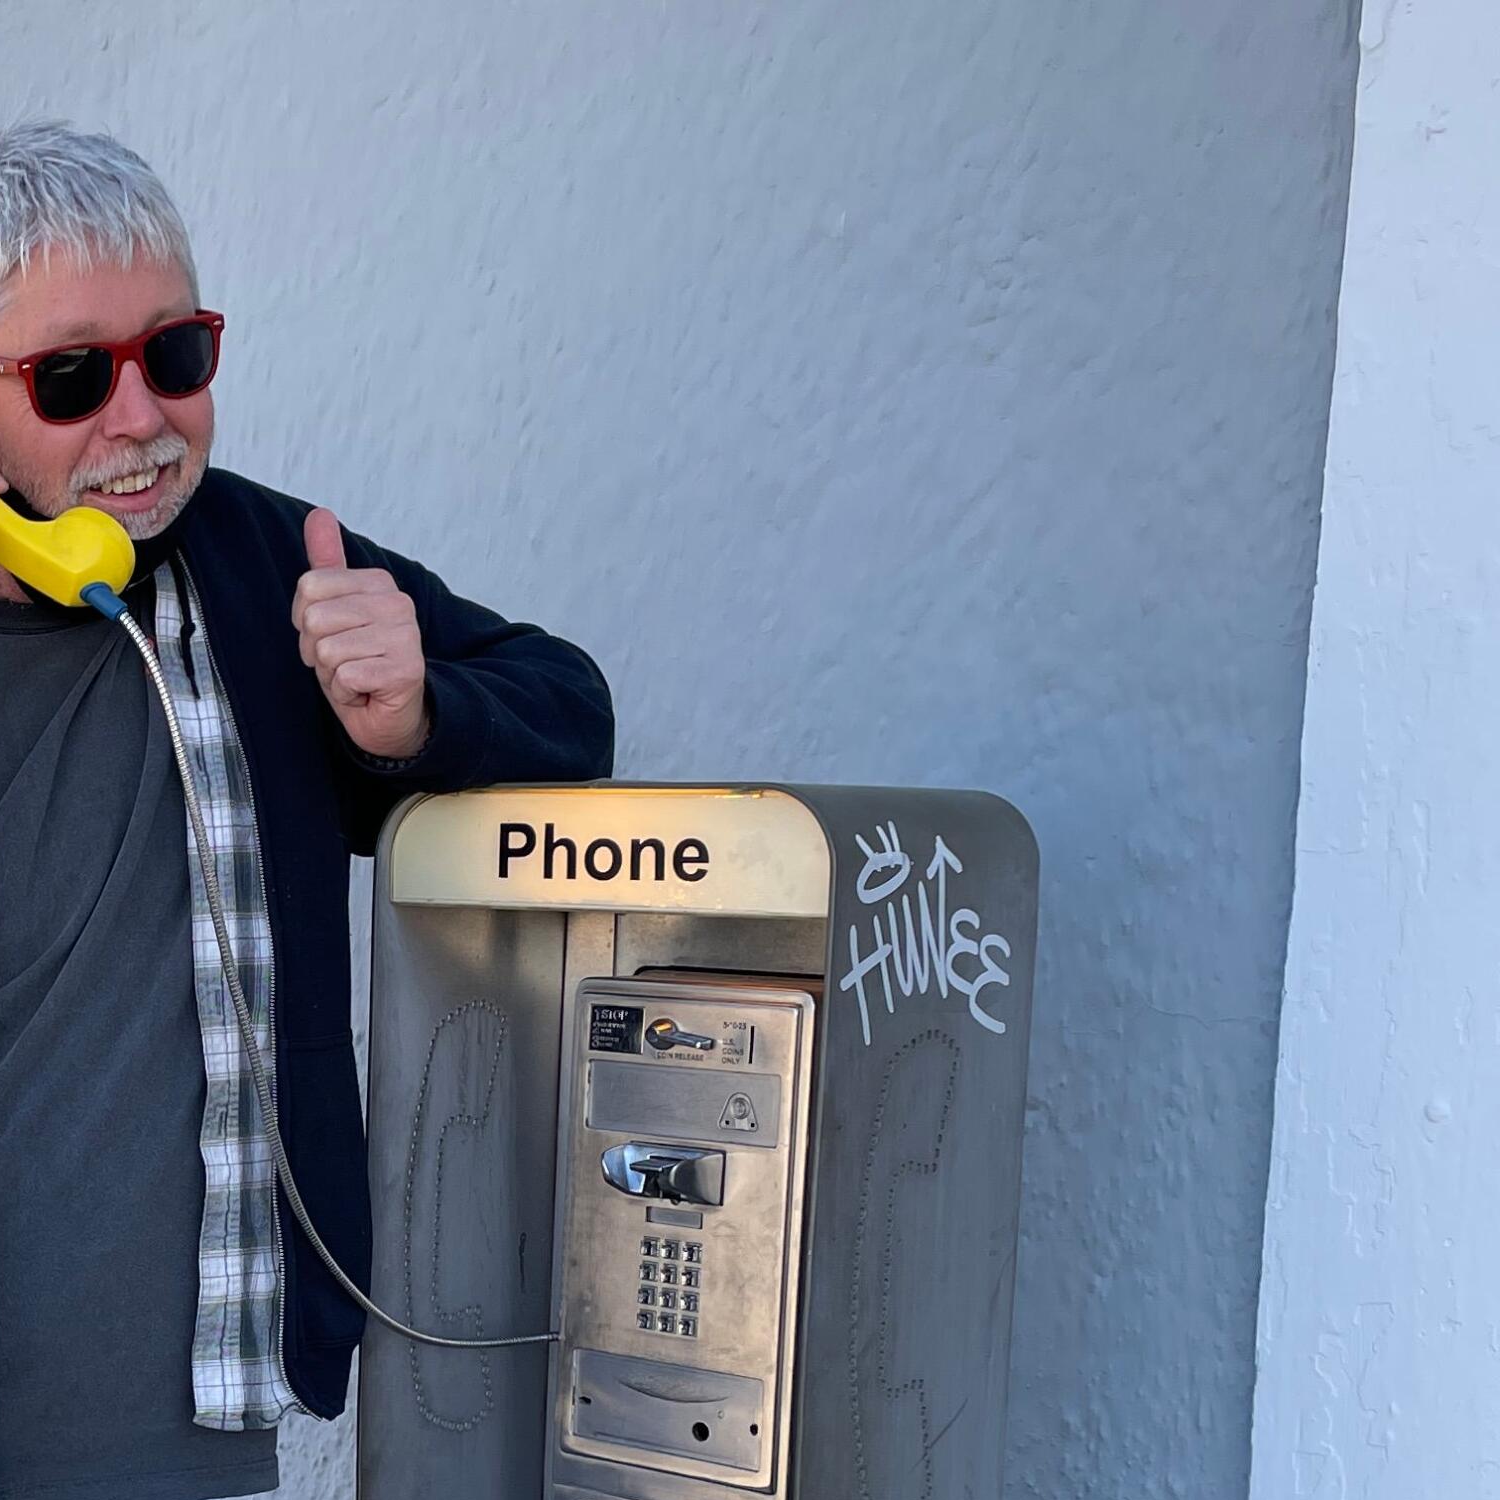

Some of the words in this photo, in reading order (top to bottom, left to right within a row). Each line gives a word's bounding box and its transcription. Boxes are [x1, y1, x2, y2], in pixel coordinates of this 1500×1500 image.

[498, 822, 709, 882] Phone
[657, 1051, 674, 1060] COIN
[674, 1052, 705, 1062] RELEASE
[721, 1056, 740, 1065] ONLY
